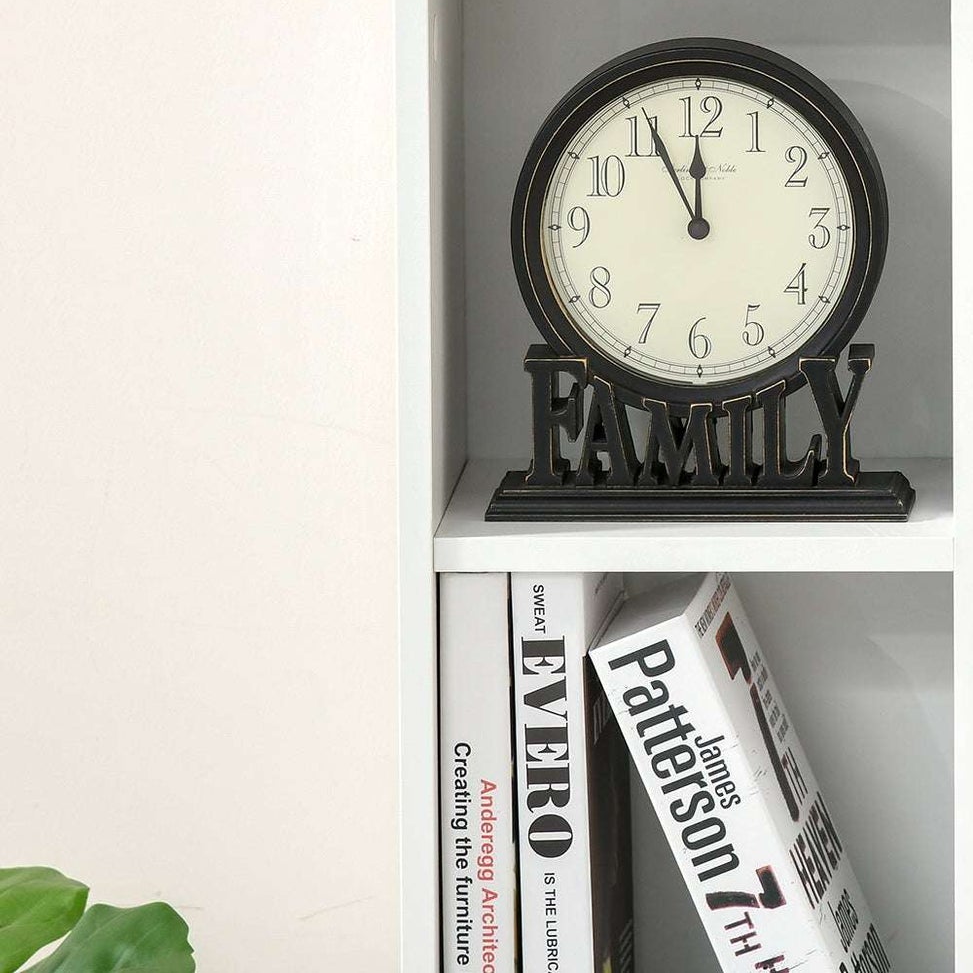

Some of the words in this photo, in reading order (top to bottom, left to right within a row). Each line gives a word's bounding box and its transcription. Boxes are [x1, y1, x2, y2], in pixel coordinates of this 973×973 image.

[625, 115, 661, 158] 11
[678, 95, 723, 138] 12
[746, 111, 766, 152] 1
[587, 154, 625, 197] 10
[784, 146, 808, 188] 2
[567, 206, 590, 248] 9
[808, 207, 831, 249] 3
[588, 266, 611, 308] 8
[783, 262, 808, 305] 4
[637, 303, 661, 344] 7
[688, 317, 712, 359] 6
[742, 304, 764, 346] 5
[523, 344, 875, 485] FAMILY
[533, 584, 546, 634] SWEAT
[521, 635, 574, 858] EVERO
[607, 639, 740, 882] Patterson
[451, 742, 472, 830] Creating
[693, 735, 741, 810] James
[477, 779, 497, 881] Anderegg
[789, 791, 843, 910] HEAVEN
[455, 837, 472, 870] the
[544, 872, 556, 885] IS
[455, 876, 472, 966] furniture
[544, 889, 557, 916] THE
[827, 888, 859, 953] James
[546, 920, 560, 973] LUBRIC
